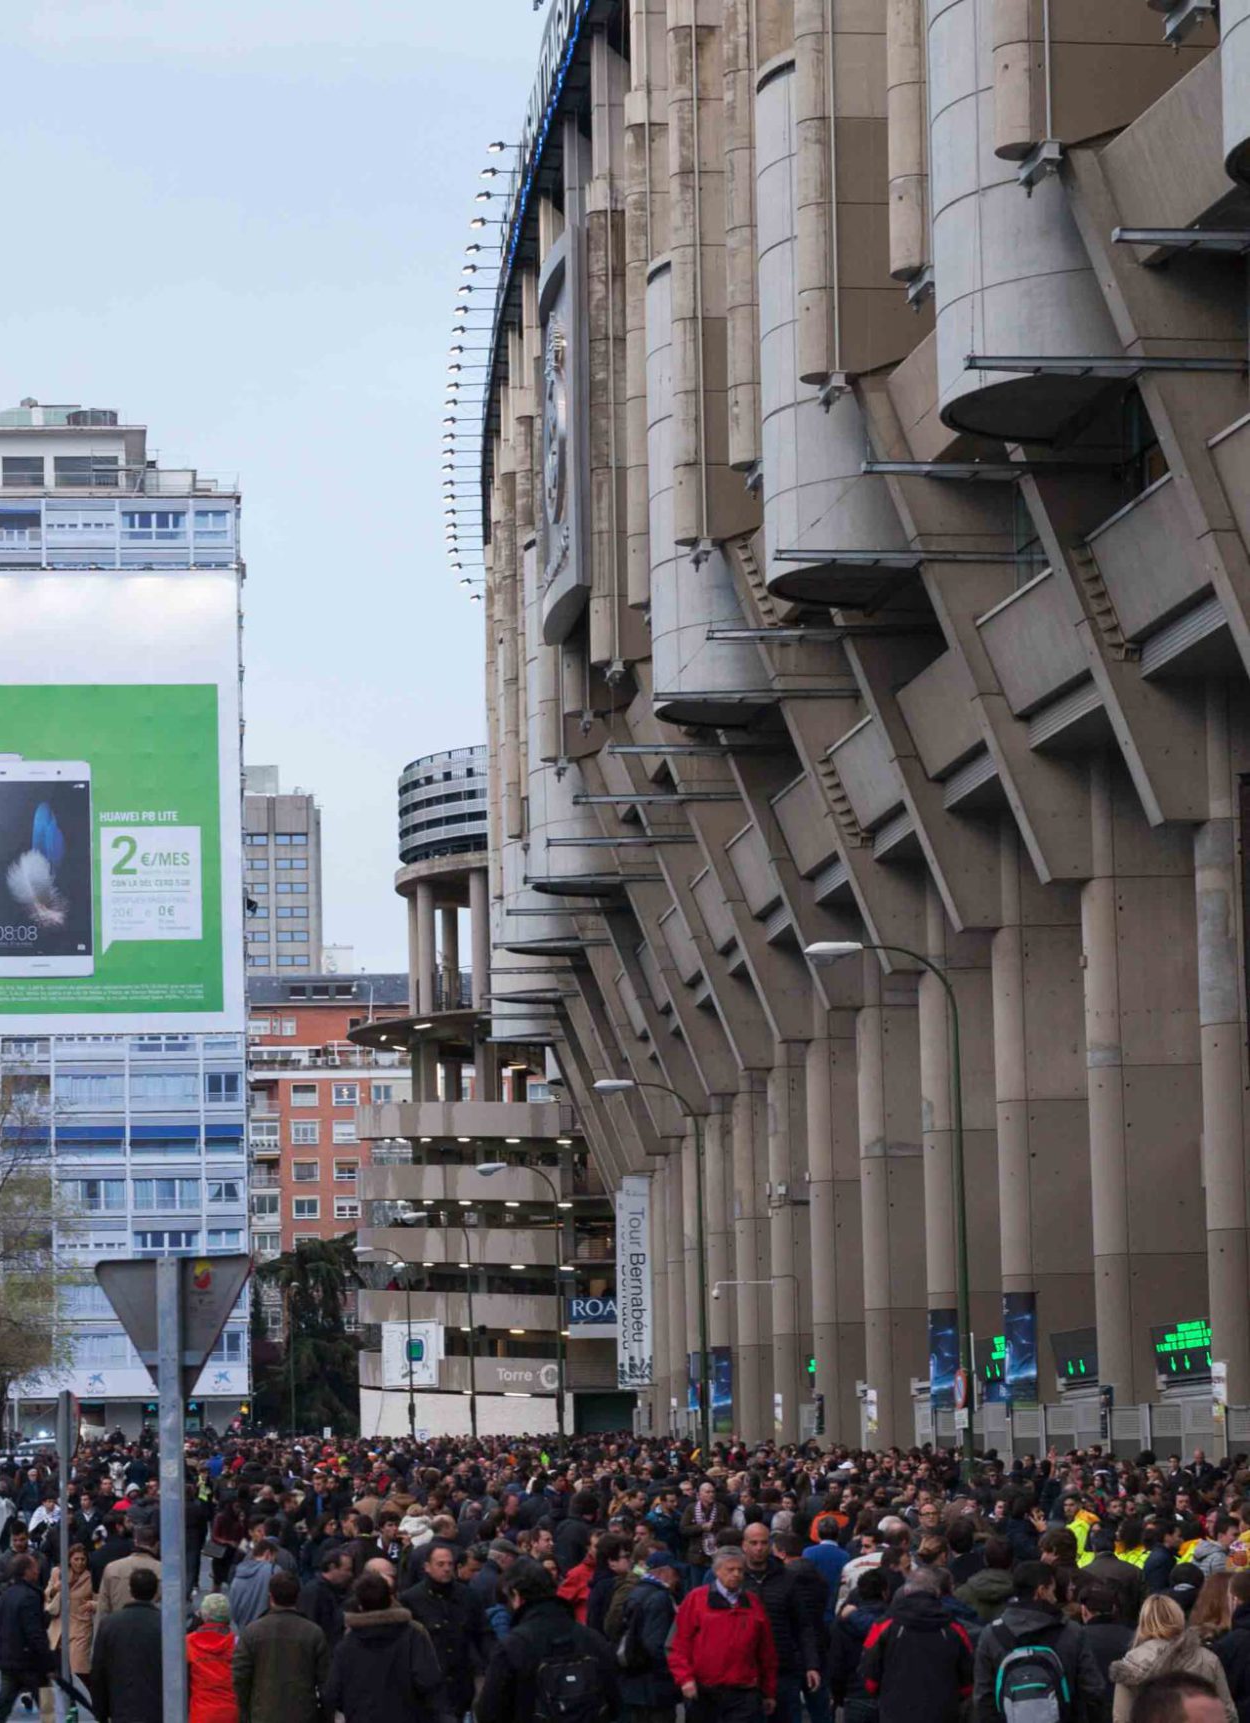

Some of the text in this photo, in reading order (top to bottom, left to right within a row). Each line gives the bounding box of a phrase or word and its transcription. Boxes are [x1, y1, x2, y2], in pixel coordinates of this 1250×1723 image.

[99, 811, 139, 822] HUAWEI
[158, 811, 179, 821] LITE
[111, 835, 138, 875] 2
[629, 1207, 645, 1246] Tour
[629, 1253, 648, 1343] Bernabéu
[496, 1367, 533, 1381] Torre
